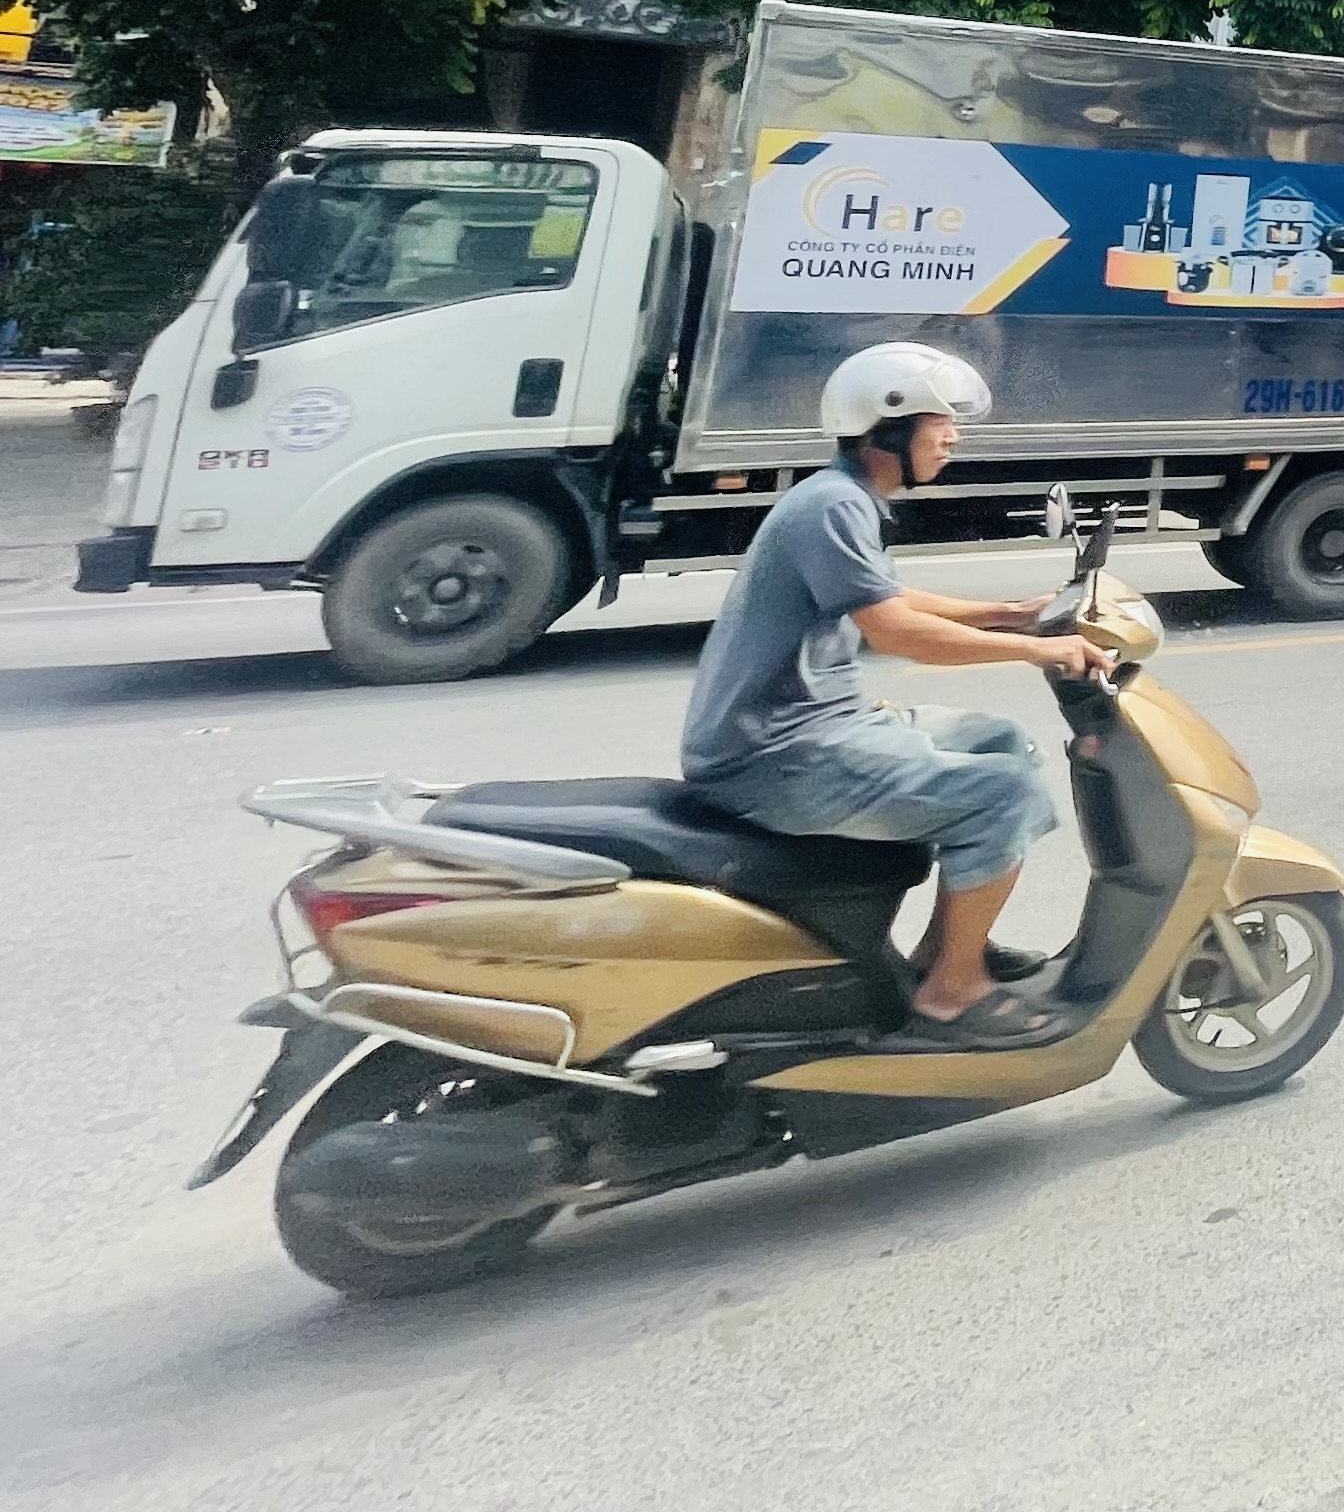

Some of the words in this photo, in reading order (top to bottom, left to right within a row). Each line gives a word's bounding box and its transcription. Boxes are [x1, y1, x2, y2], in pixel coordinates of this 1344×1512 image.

[841, 194, 965, 233] Hare
[787, 240, 835, 253] CÔNG
[840, 242, 860, 253] TY
[782, 258, 890, 279] QUANG
[902, 261, 975, 281] MINH
